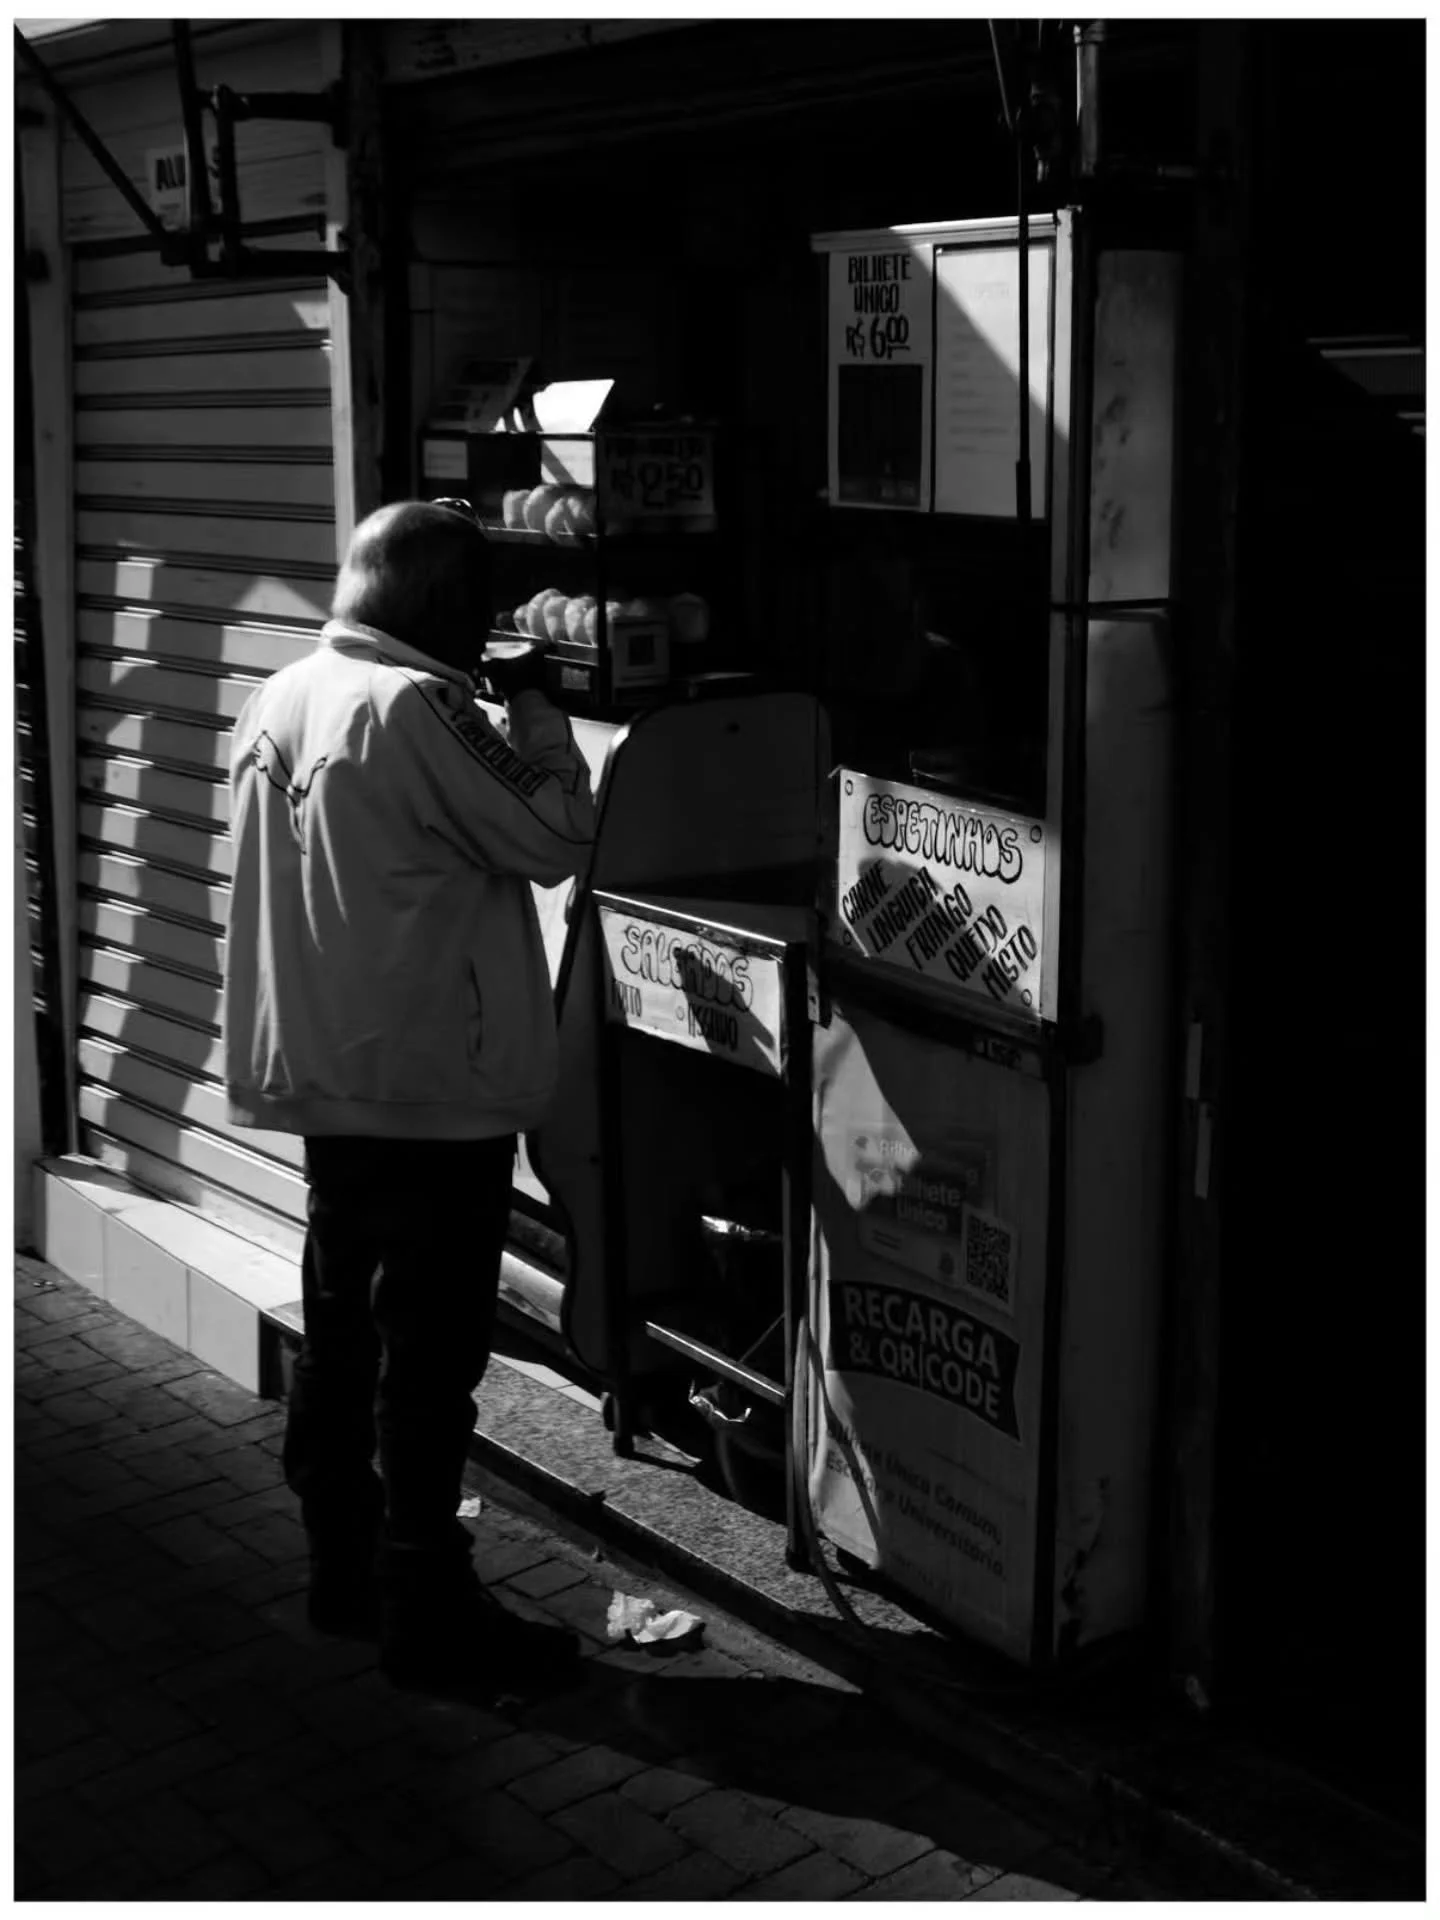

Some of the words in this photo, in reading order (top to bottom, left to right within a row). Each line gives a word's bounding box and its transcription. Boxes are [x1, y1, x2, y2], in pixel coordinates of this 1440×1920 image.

[848, 253, 912, 283] BILHETE
[863, 793, 1023, 884] ESPETINHOS
[842, 860, 890, 926] CARNE
[904, 883, 973, 971] FRANGO
[621, 924, 754, 1013] SALGADOS
[981, 925, 1038, 1001] MISTO
[841, 1285, 1001, 1380] RECARGA
[850, 1330, 873, 1366] &
[924, 1351, 1002, 1422] CODE
